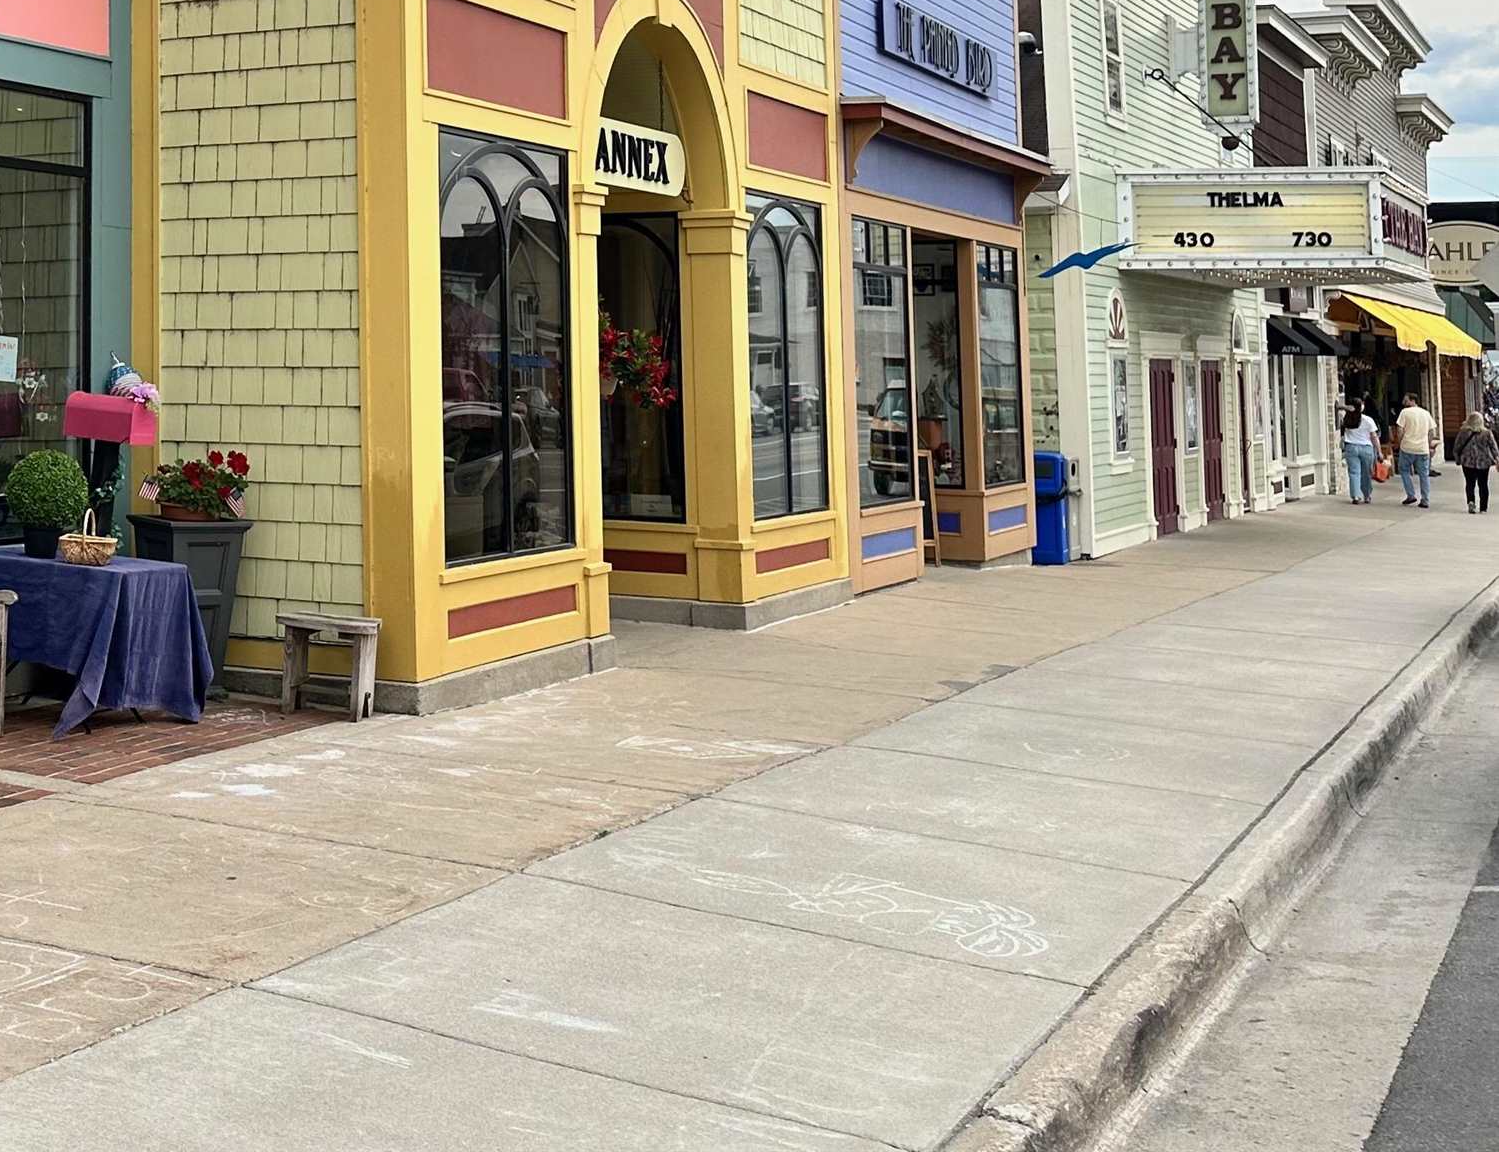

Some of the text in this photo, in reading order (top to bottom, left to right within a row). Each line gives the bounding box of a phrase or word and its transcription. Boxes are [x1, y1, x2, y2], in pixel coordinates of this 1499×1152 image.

[1210, 2, 1245, 100] BAY
[595, 127, 670, 184] ANNEX
[1206, 192, 1284, 208] THELMA
[1173, 232, 1332, 248] 430 730
